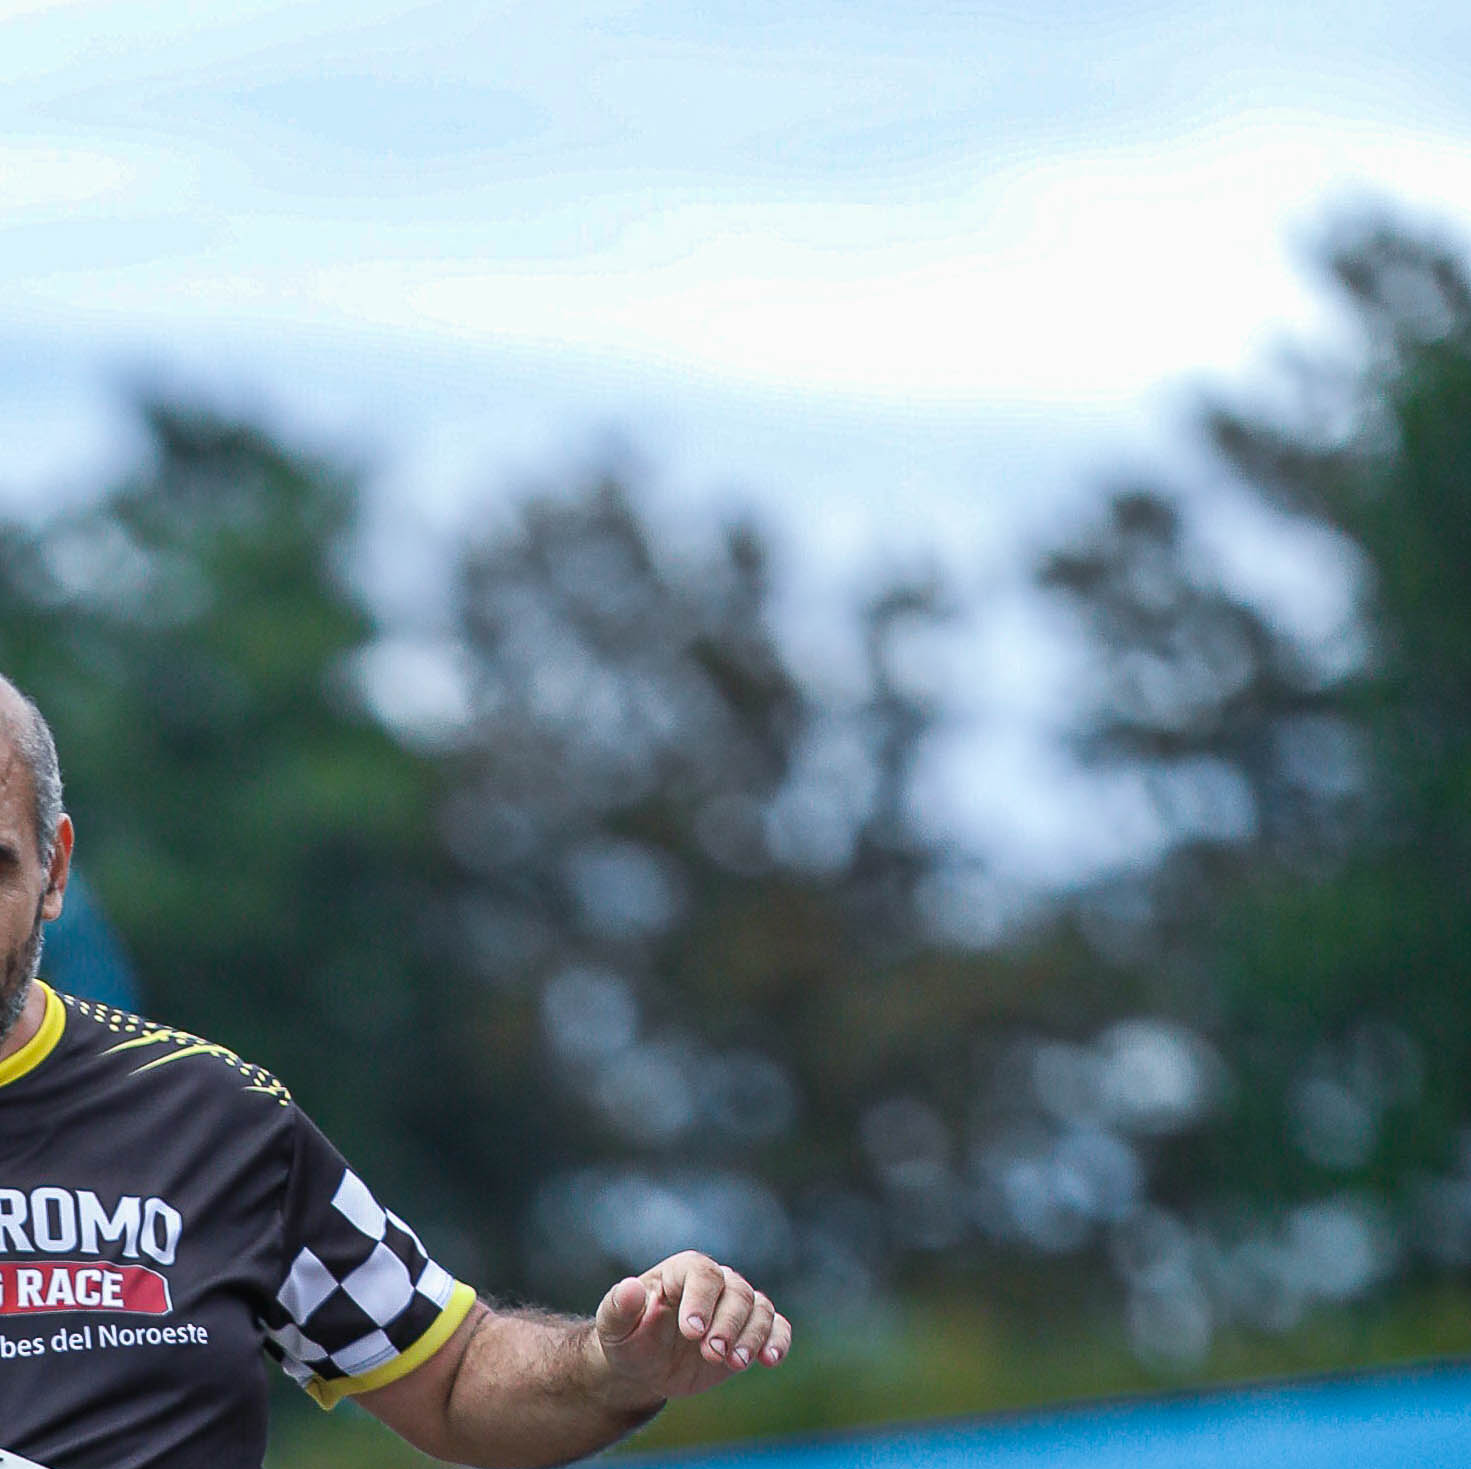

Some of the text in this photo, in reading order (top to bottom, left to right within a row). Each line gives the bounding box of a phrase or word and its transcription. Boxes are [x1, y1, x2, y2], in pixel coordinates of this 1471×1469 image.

[17, 1268, 125, 1308] RACE
[54, 1326, 92, 1353] del
[99, 1324, 208, 1349] Noroeste
